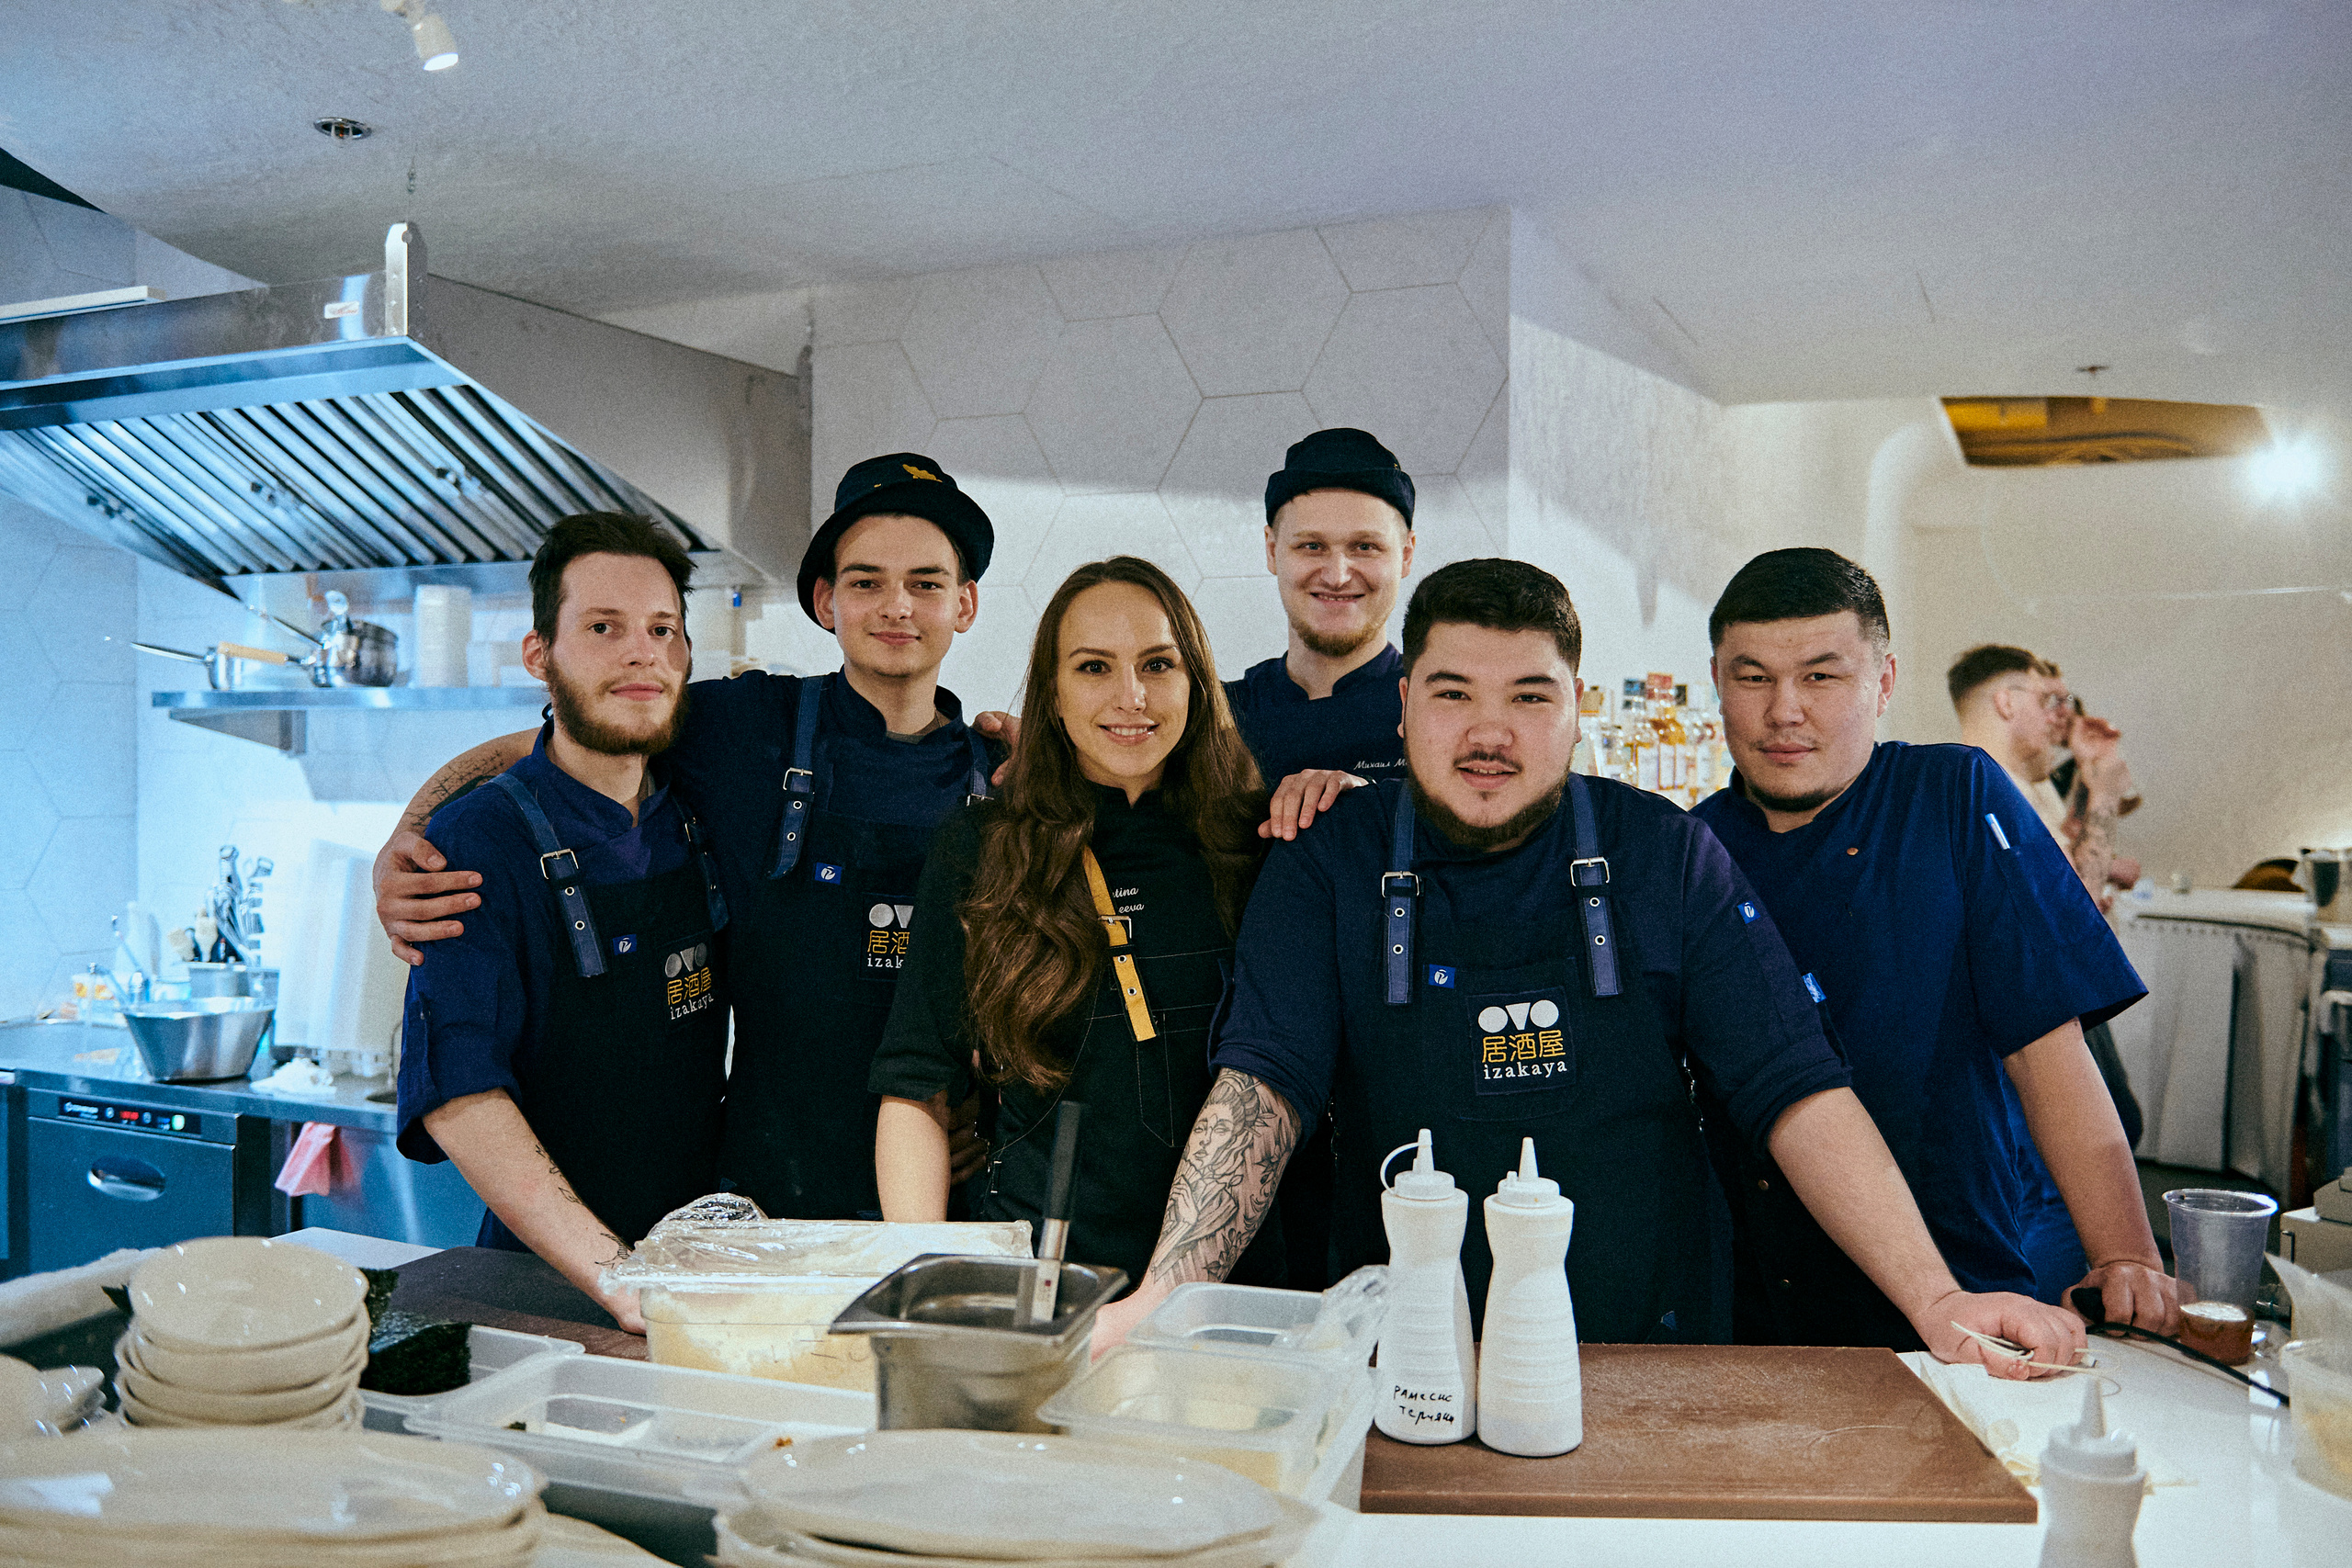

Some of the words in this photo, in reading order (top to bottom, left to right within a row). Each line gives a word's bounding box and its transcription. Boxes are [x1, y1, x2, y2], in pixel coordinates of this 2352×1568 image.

[1393, 758, 1408, 768] М
[1117, 903, 1145, 914] eeva
[866, 930, 910, 954] 居酒
[866, 953, 904, 969] izak
[667, 966, 712, 1006] 居酒屋
[670, 993, 715, 1021] izakaya
[1481, 1029, 1566, 1064] 居酒屋
[1483, 1061, 1568, 1080] izakaya
